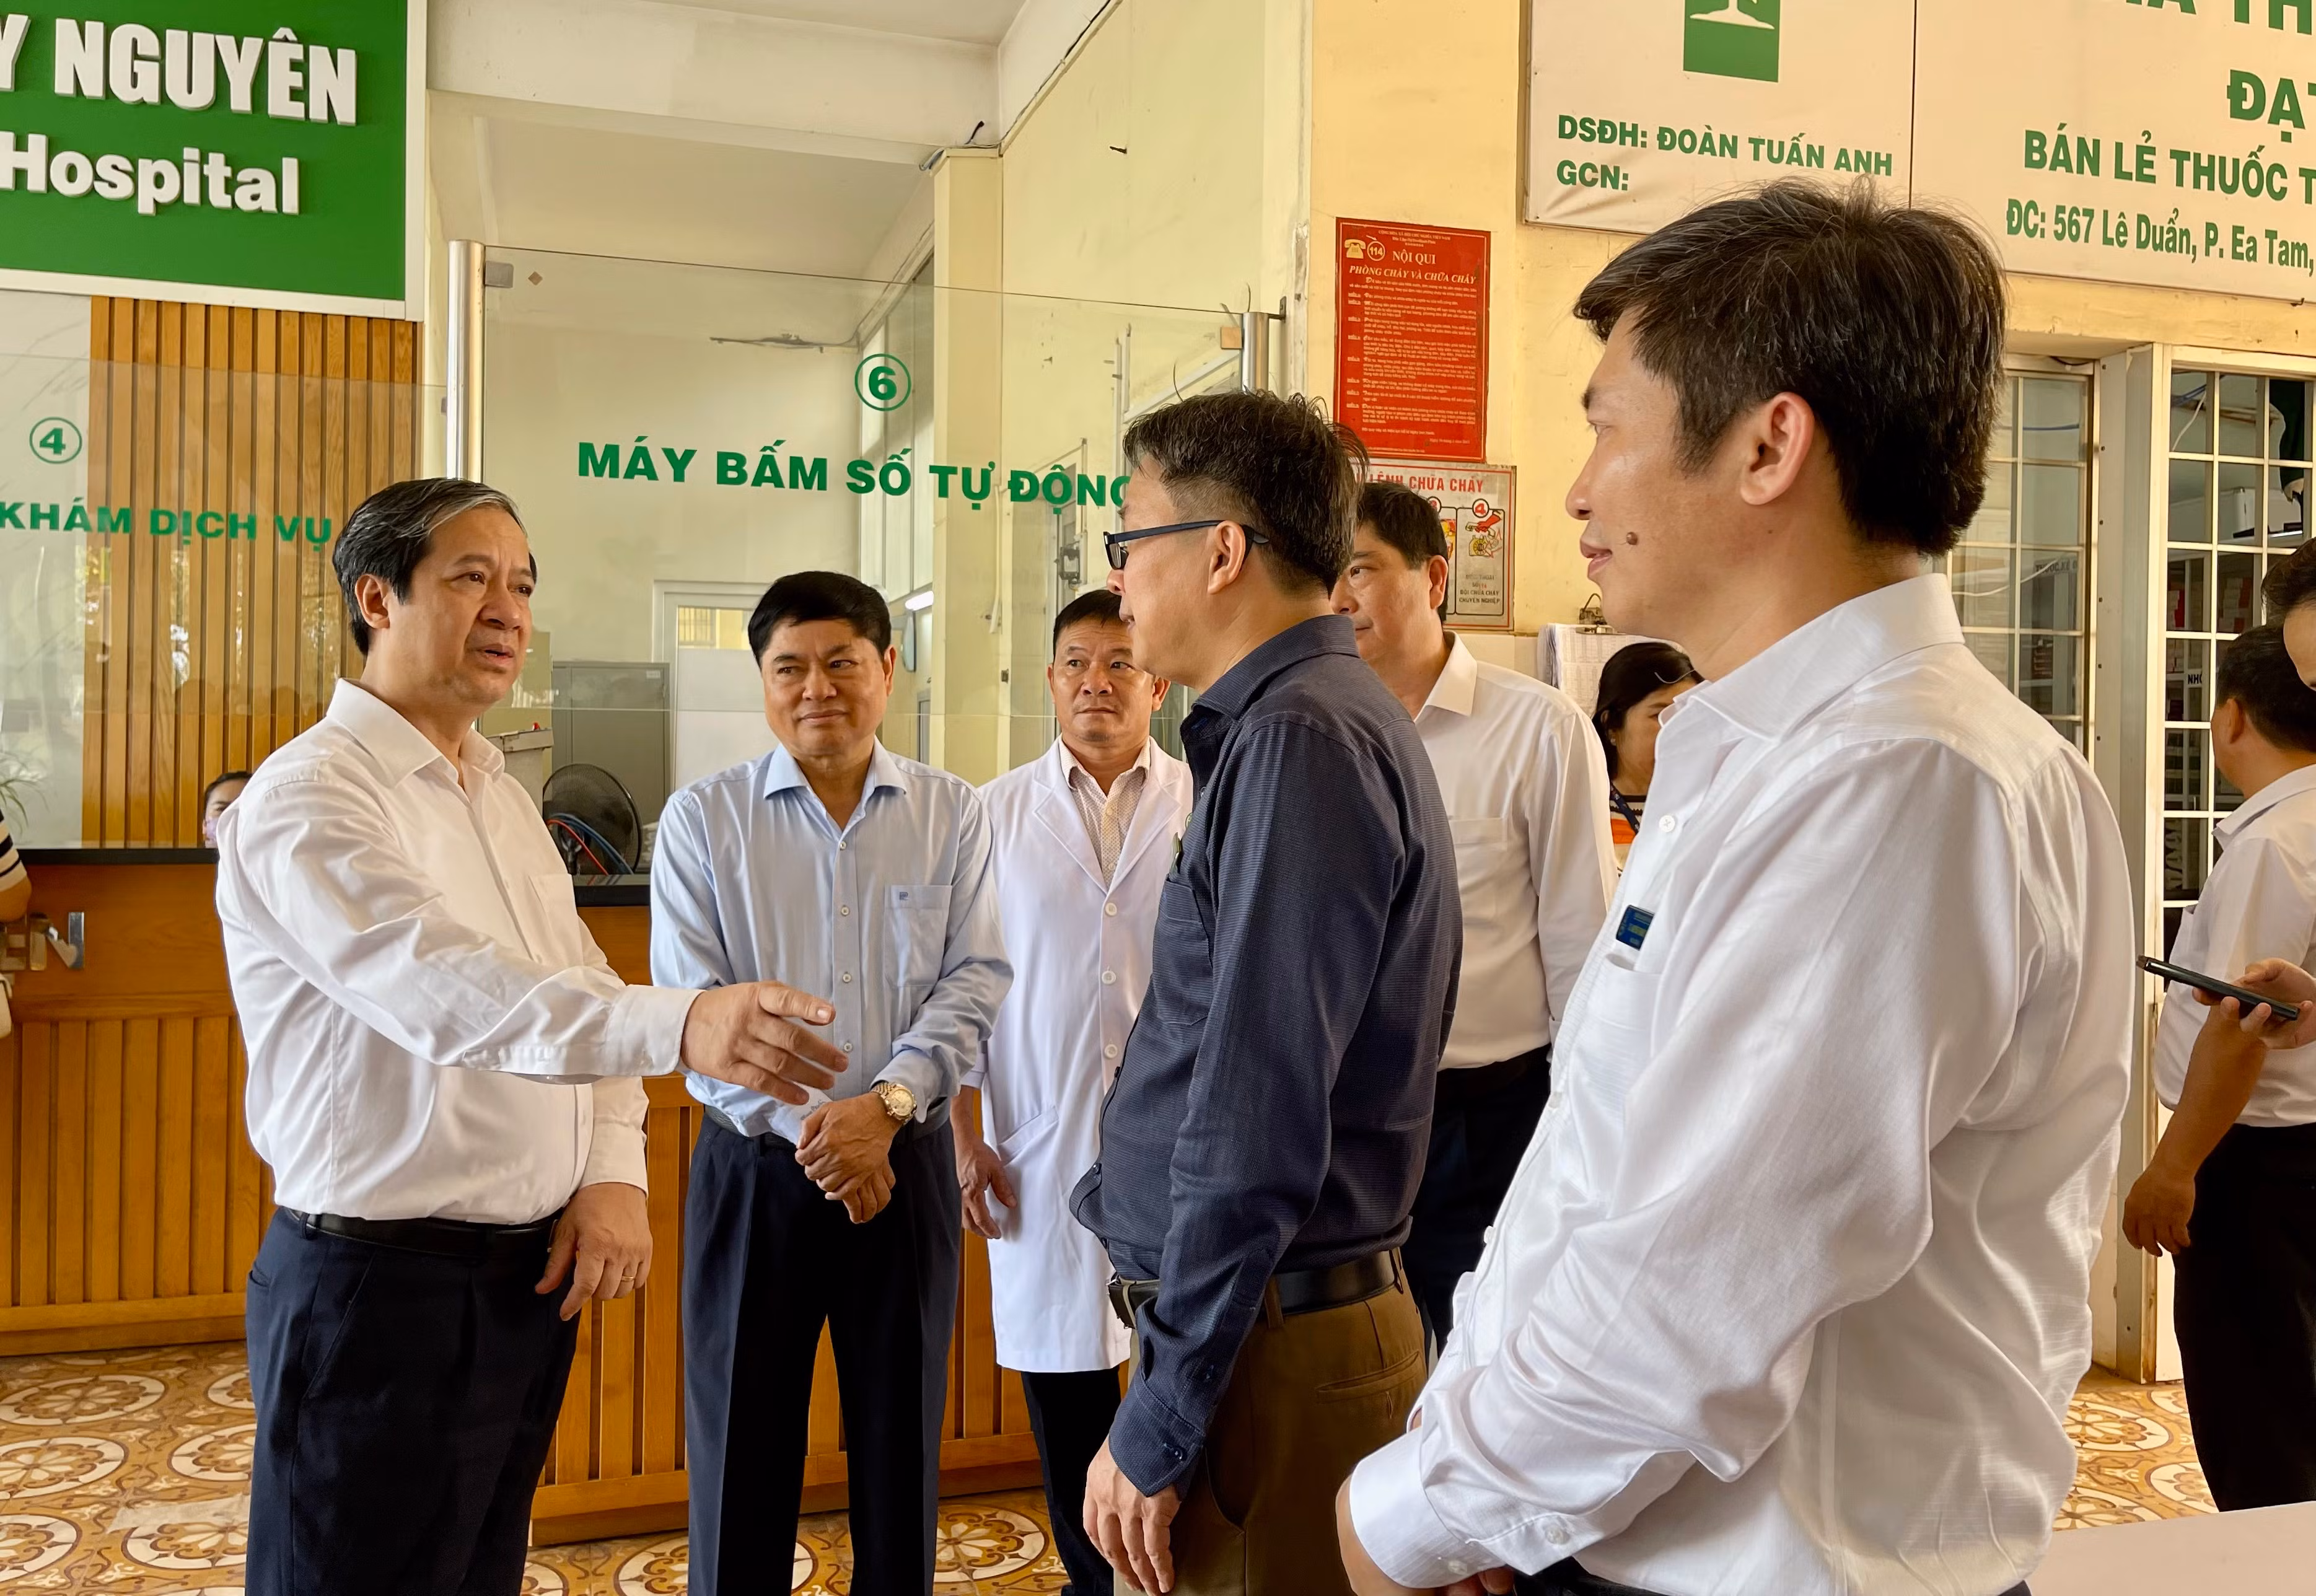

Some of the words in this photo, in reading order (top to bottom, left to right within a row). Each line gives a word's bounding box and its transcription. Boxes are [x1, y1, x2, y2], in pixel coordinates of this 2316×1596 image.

[54, 17, 356, 126] NGUYÊN
[2227, 69, 2316, 142] ĐẠ
[1558, 114, 1648, 149] DSĐH:
[1657, 125, 1739, 159] ĐOÀN
[1748, 132, 1825, 169] TUẤN
[1833, 147, 1893, 177] ANH
[2024, 123, 2101, 177] BÁN
[2114, 130, 2157, 185] LẺ
[2170, 144, 2288, 202] THUỐC
[0, 131, 300, 216] Hospital
[1556, 159, 1630, 191] GCN:
[1369, 246, 1384, 256] 114
[1392, 248, 1413, 264] NỘI
[1415, 253, 1436, 266] QUI
[2006, 198, 2046, 239] ĐC:
[2053, 204, 2095, 244] 567
[2102, 209, 2128, 249] Lê
[2136, 208, 2198, 264] Duẩn,
[2204, 222, 2224, 258] P.
[2232, 225, 2258, 263] Ea
[2265, 229, 2315, 276] Tam,
[1349, 265, 1382, 276] PHÒNG
[1384, 268, 1409, 278] CHÁY
[1411, 269, 1422, 279] VÀ
[1451, 273, 1476, 284] CHÁY
[867, 365, 898, 401] 6
[38, 426, 66, 457] 4
[577, 435, 698, 483] MÁY
[716, 439, 828, 492] BẤM
[845, 447, 913, 497] SỐ
[928, 460, 996, 512] TỰ
[1449, 475, 1483, 493] CHÁY
[0, 496, 133, 534] KHÁM
[149, 509, 257, 547] DỊCH
[275, 515, 333, 553] VỤ
[1475, 502, 1486, 515] 4
